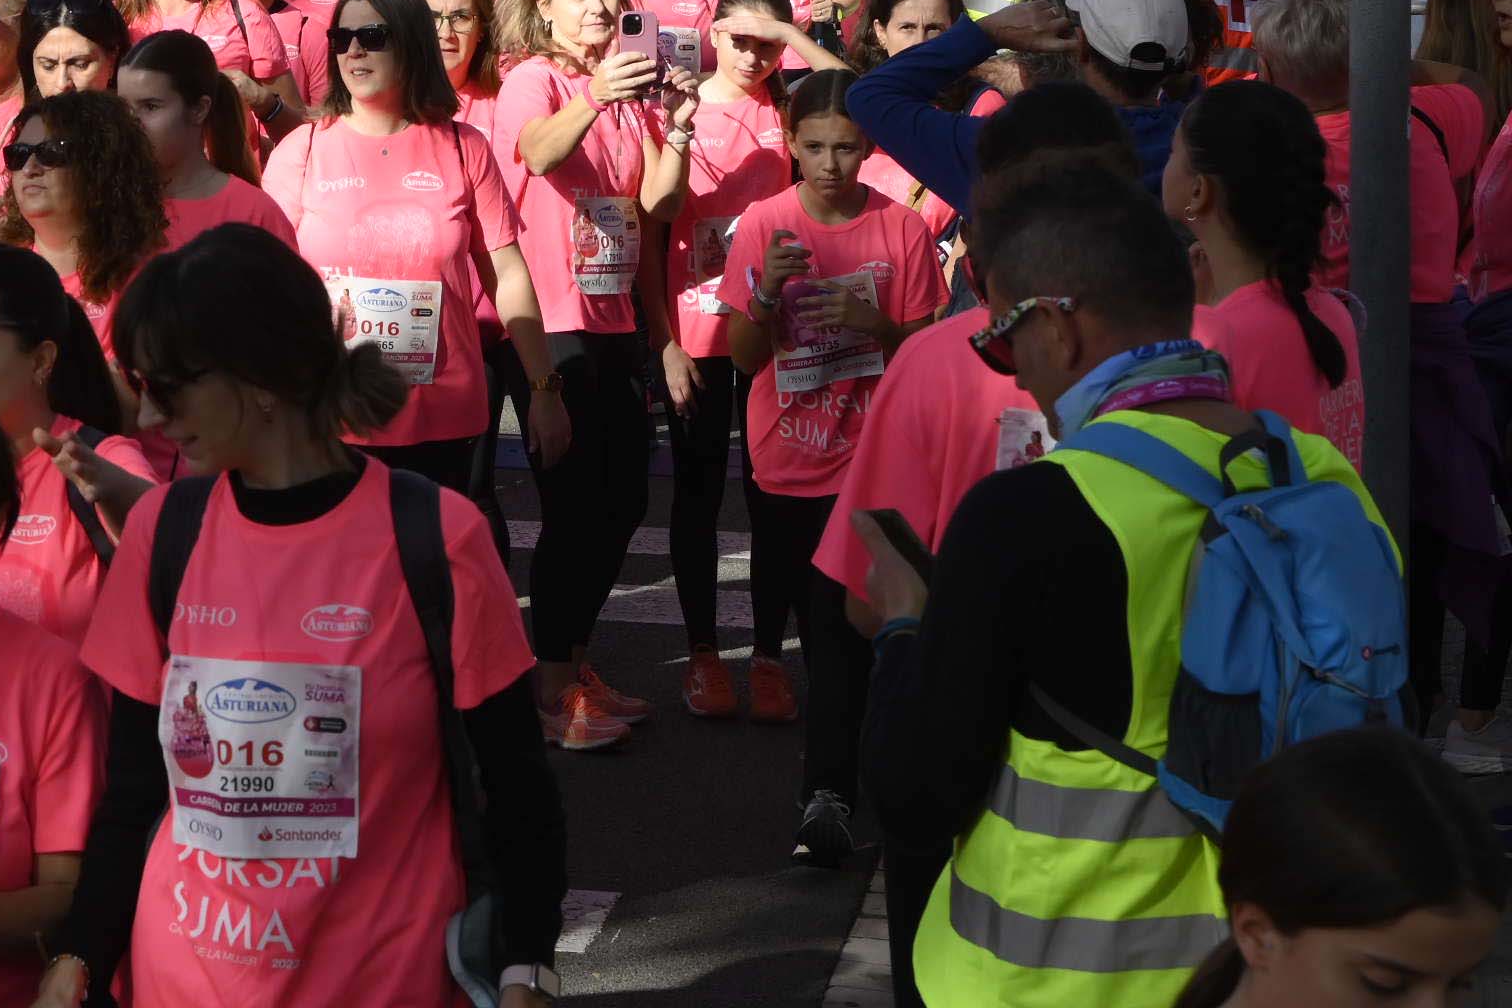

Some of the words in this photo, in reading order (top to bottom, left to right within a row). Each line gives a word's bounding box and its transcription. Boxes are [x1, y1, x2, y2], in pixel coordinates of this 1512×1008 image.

[318, 176, 366, 192] OYSHO
[362, 296, 404, 307] ASTURIANA
[361, 320, 400, 336] 016
[211, 694, 289, 713] ASTURIANA
[304, 692, 345, 703] SUMA
[217, 739, 284, 766] 016
[220, 775, 275, 793] 21990
[224, 802, 239, 813] DE
[244, 802, 259, 813] LA
[262, 802, 305, 813] MUJER
[275, 828, 343, 842] Santander
